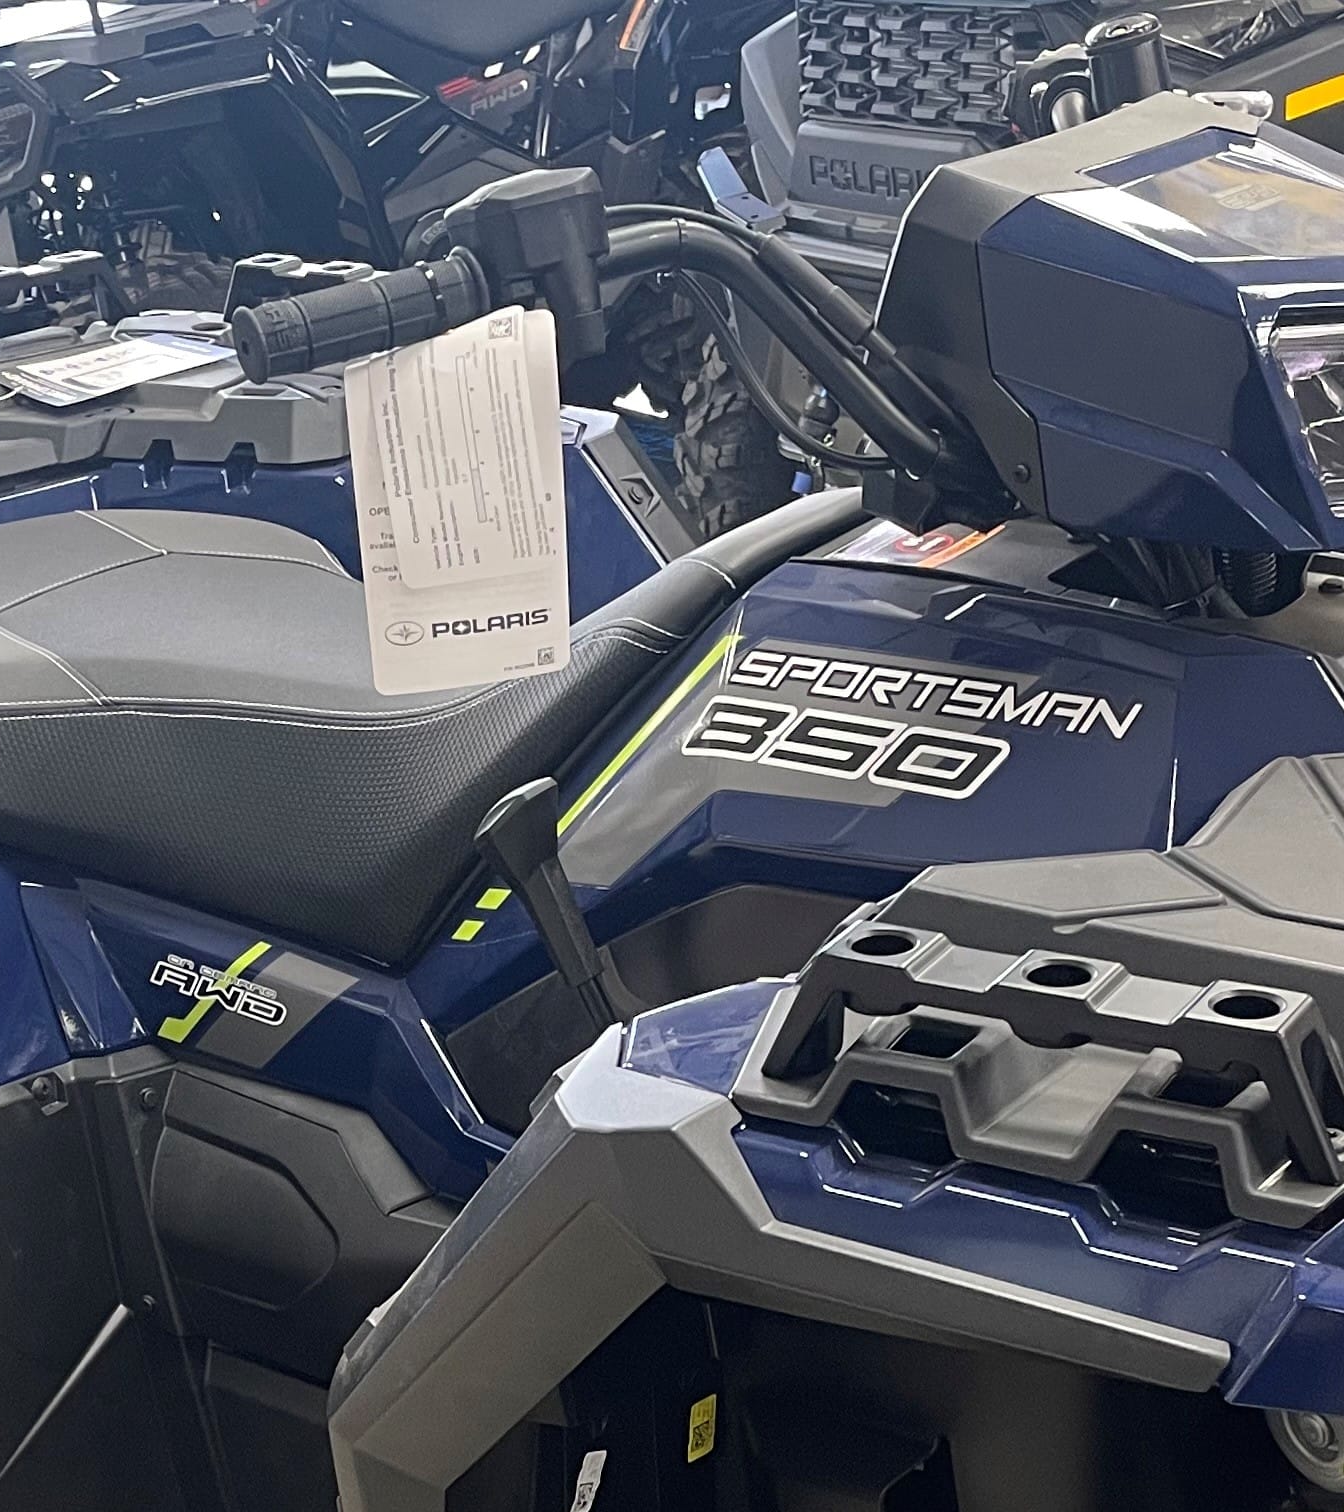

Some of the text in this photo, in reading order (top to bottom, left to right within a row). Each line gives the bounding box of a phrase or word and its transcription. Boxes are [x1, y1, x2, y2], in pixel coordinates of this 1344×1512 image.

[809, 155, 925, 198] POLARI
[431, 608, 550, 639] POLARIS
[729, 650, 1144, 740] SPORTSMAN
[681, 695, 1012, 800] 850
[149, 960, 287, 1027] AWD
